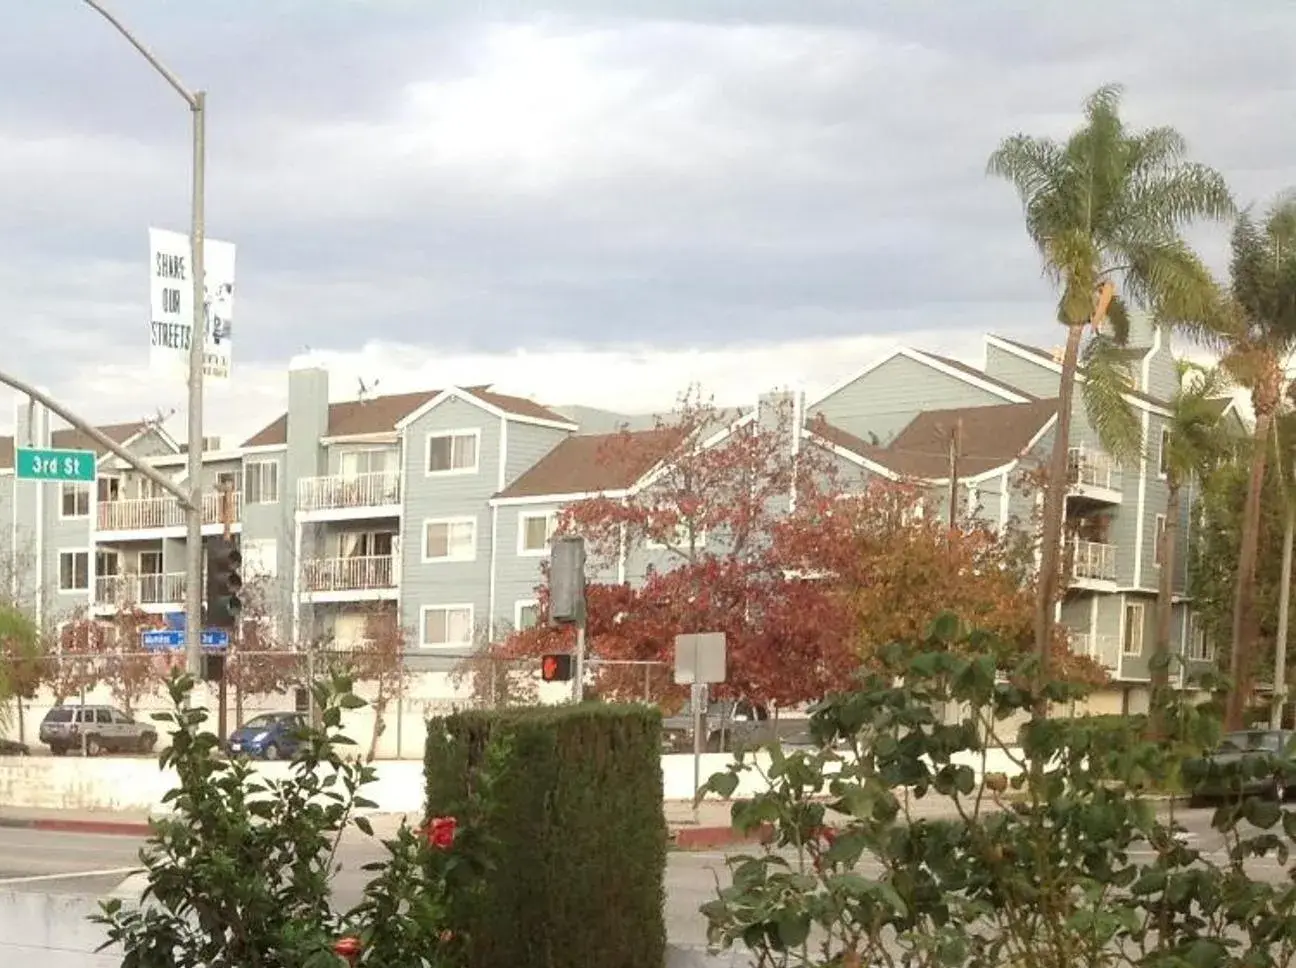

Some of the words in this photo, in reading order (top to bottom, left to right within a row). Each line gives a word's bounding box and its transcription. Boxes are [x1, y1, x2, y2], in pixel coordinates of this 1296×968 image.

[156, 251, 186, 281] SHARE
[162, 287, 181, 315] OUR
[150, 320, 192, 351] STREETS
[32, 455, 59, 474] 3rd
[63, 456, 81, 475] St
